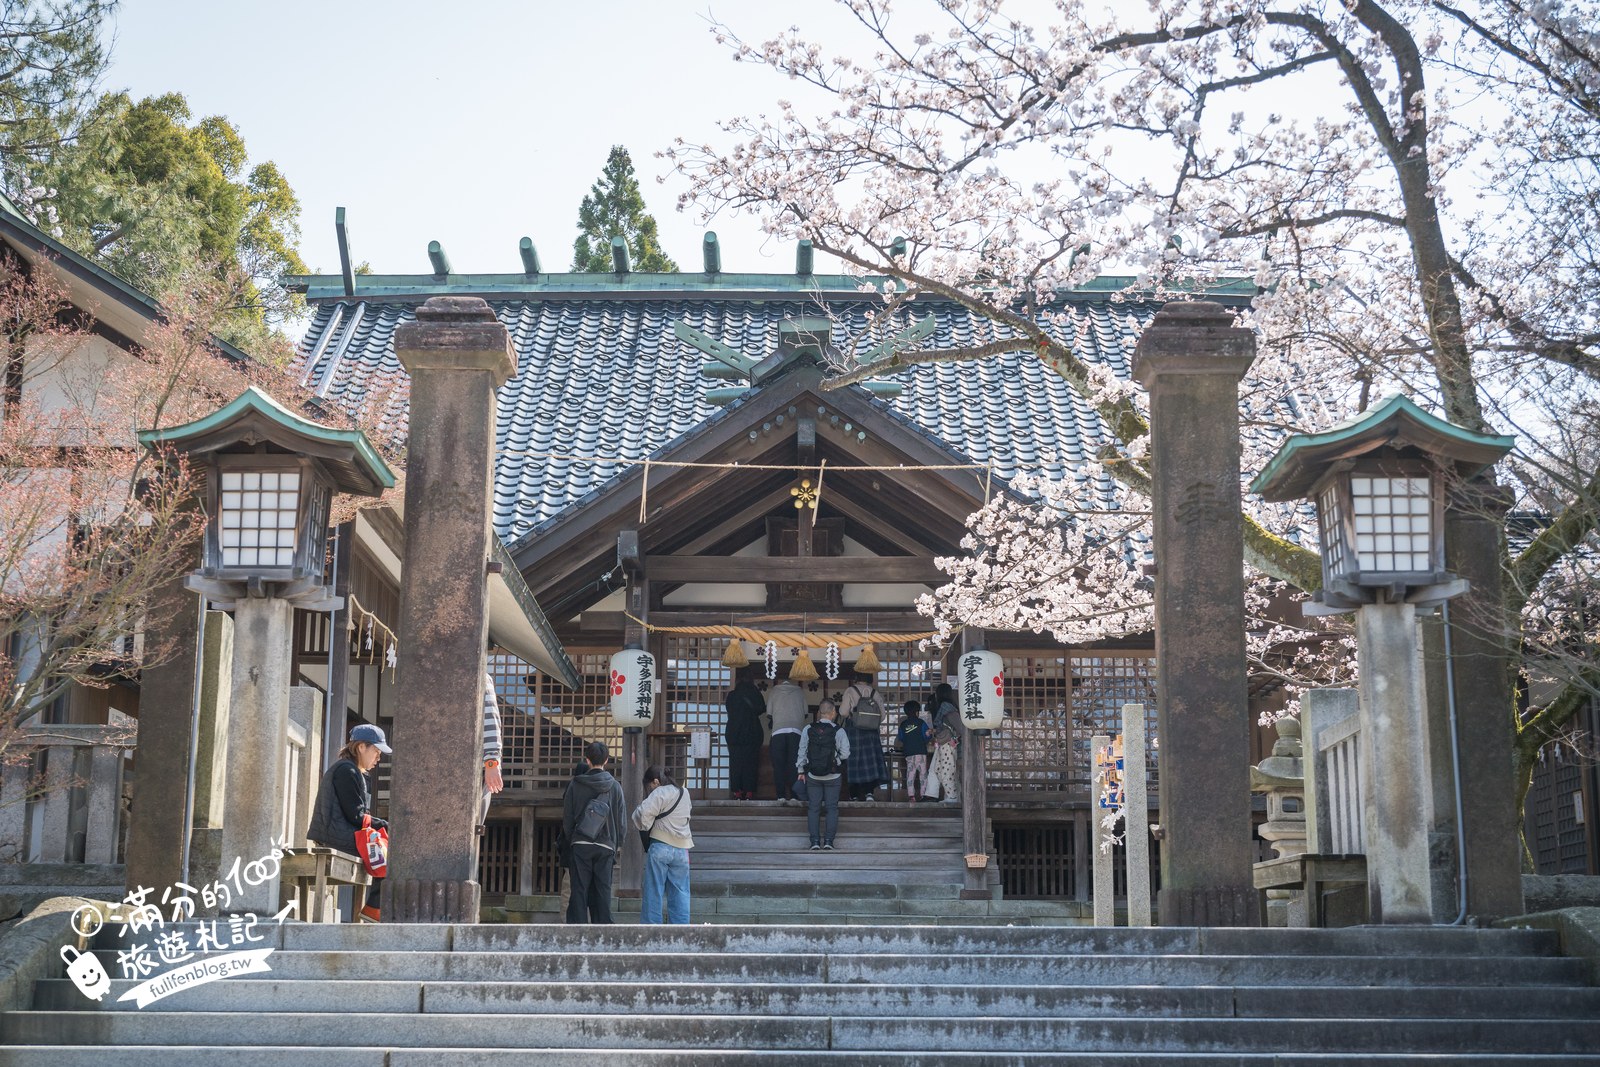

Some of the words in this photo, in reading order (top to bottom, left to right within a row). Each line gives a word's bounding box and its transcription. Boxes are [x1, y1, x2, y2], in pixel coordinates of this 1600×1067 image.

[1174, 481, 1231, 525] 奉
[634, 655, 653, 719] 宇多須神社
[963, 655, 984, 720] 宇多須神社
